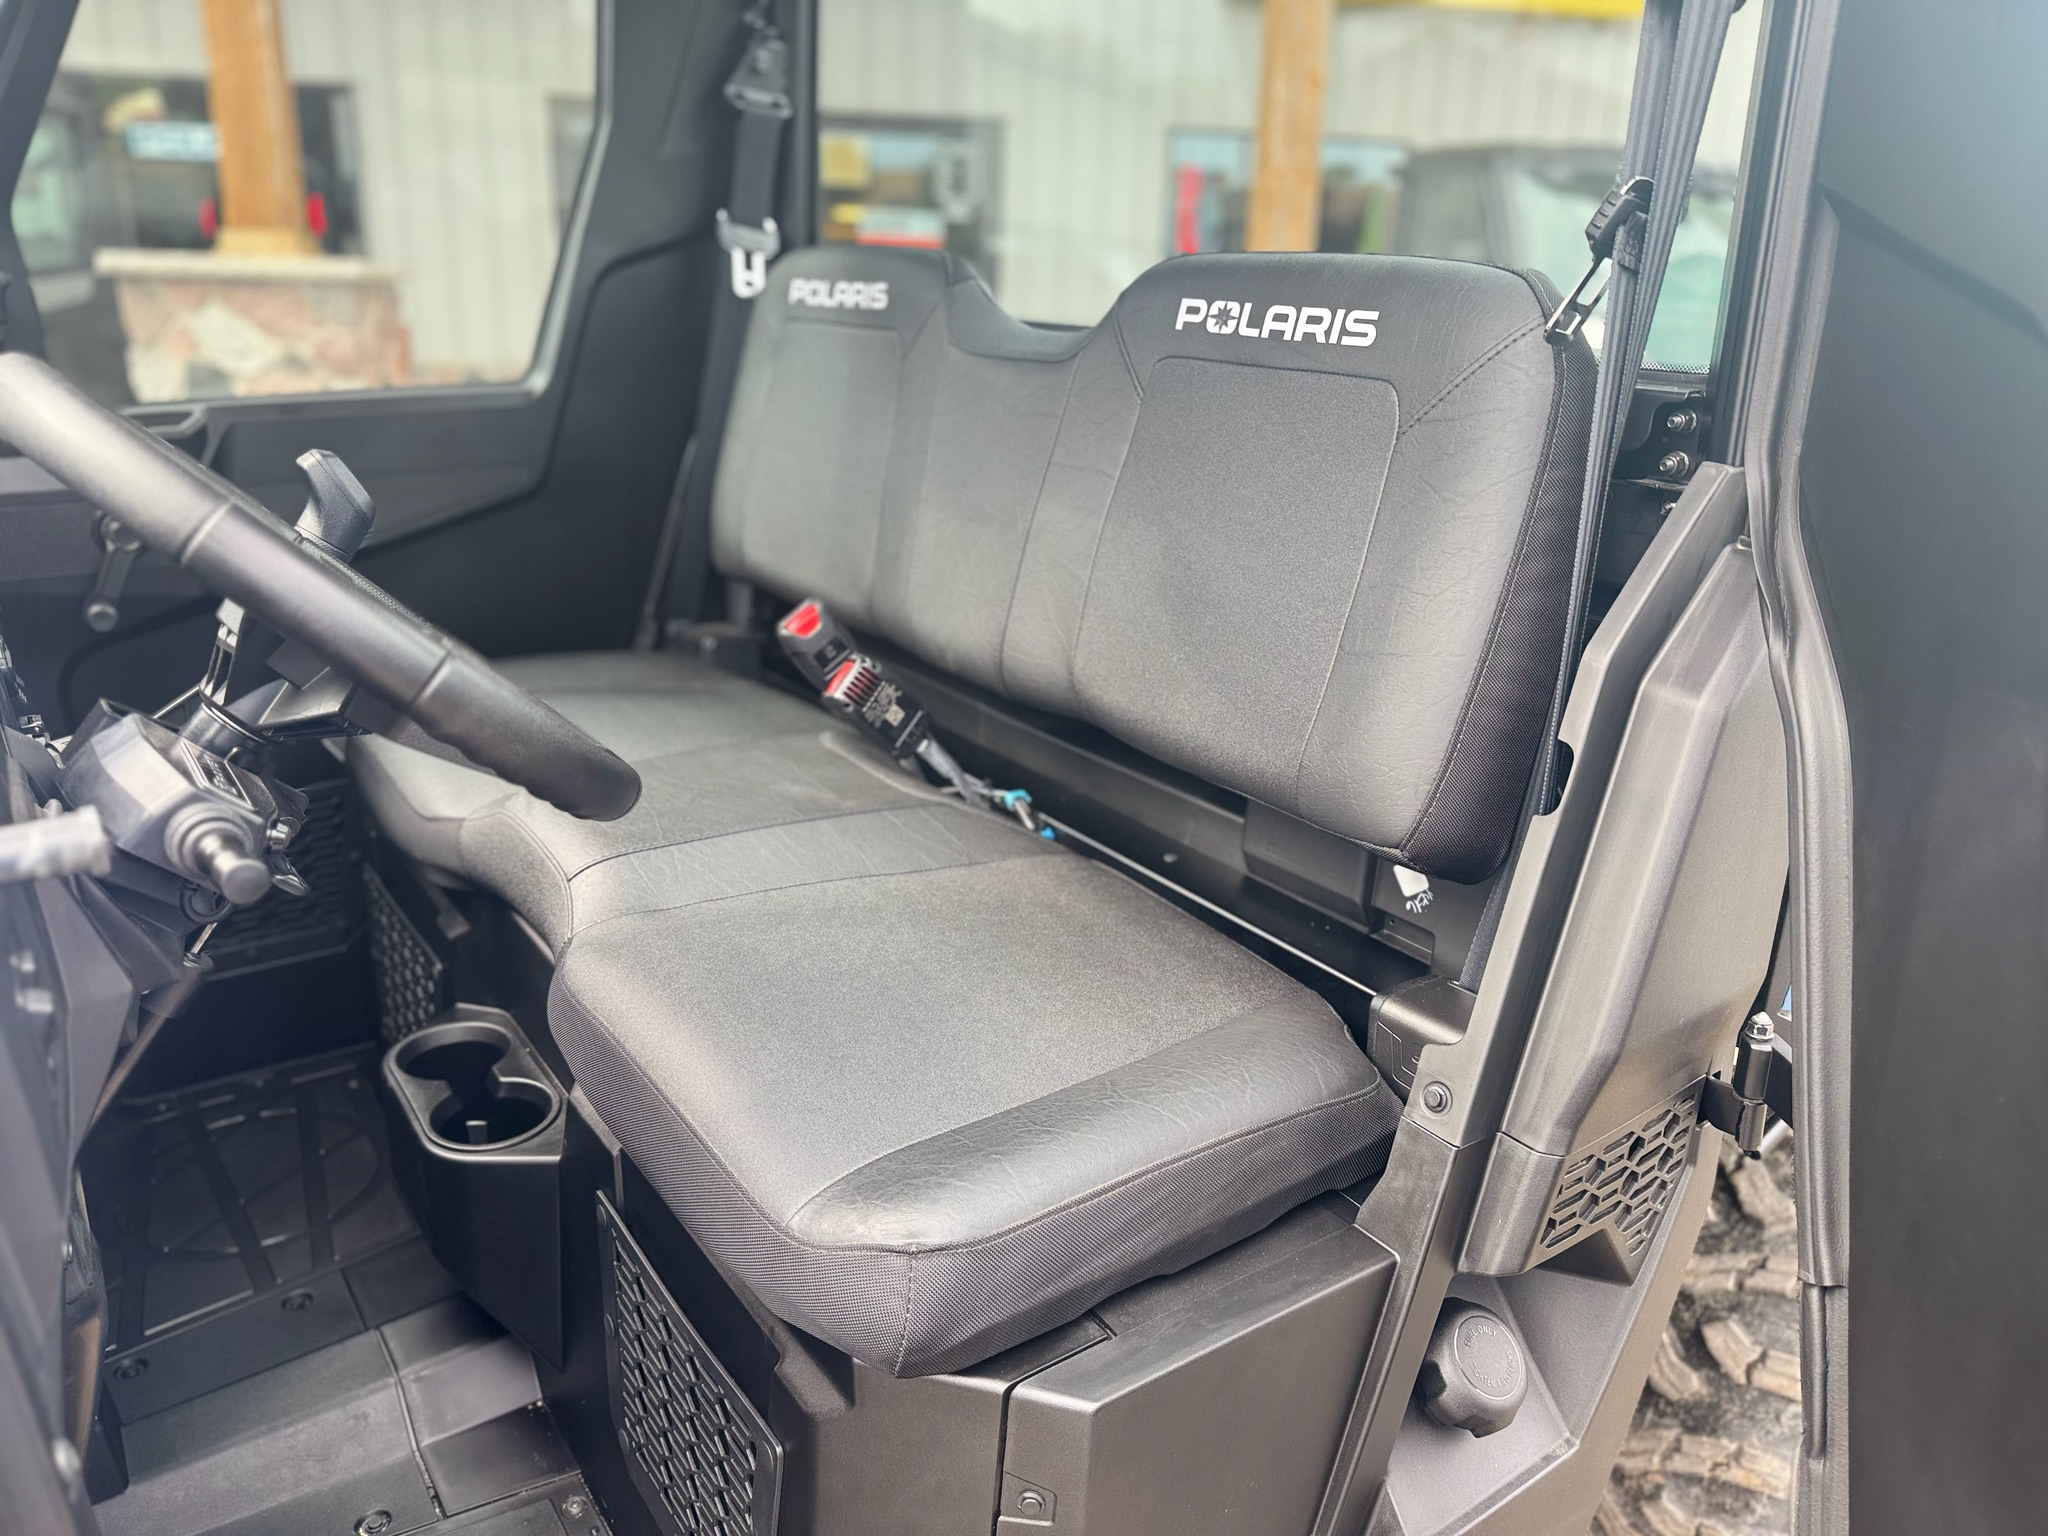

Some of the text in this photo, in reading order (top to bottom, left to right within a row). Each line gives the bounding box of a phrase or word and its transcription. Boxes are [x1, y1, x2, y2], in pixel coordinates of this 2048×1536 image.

[787, 278, 890, 311] POLARIS
[1174, 297, 1380, 347] POLARIS
[1463, 1324, 1498, 1348] FUEL ONLY
